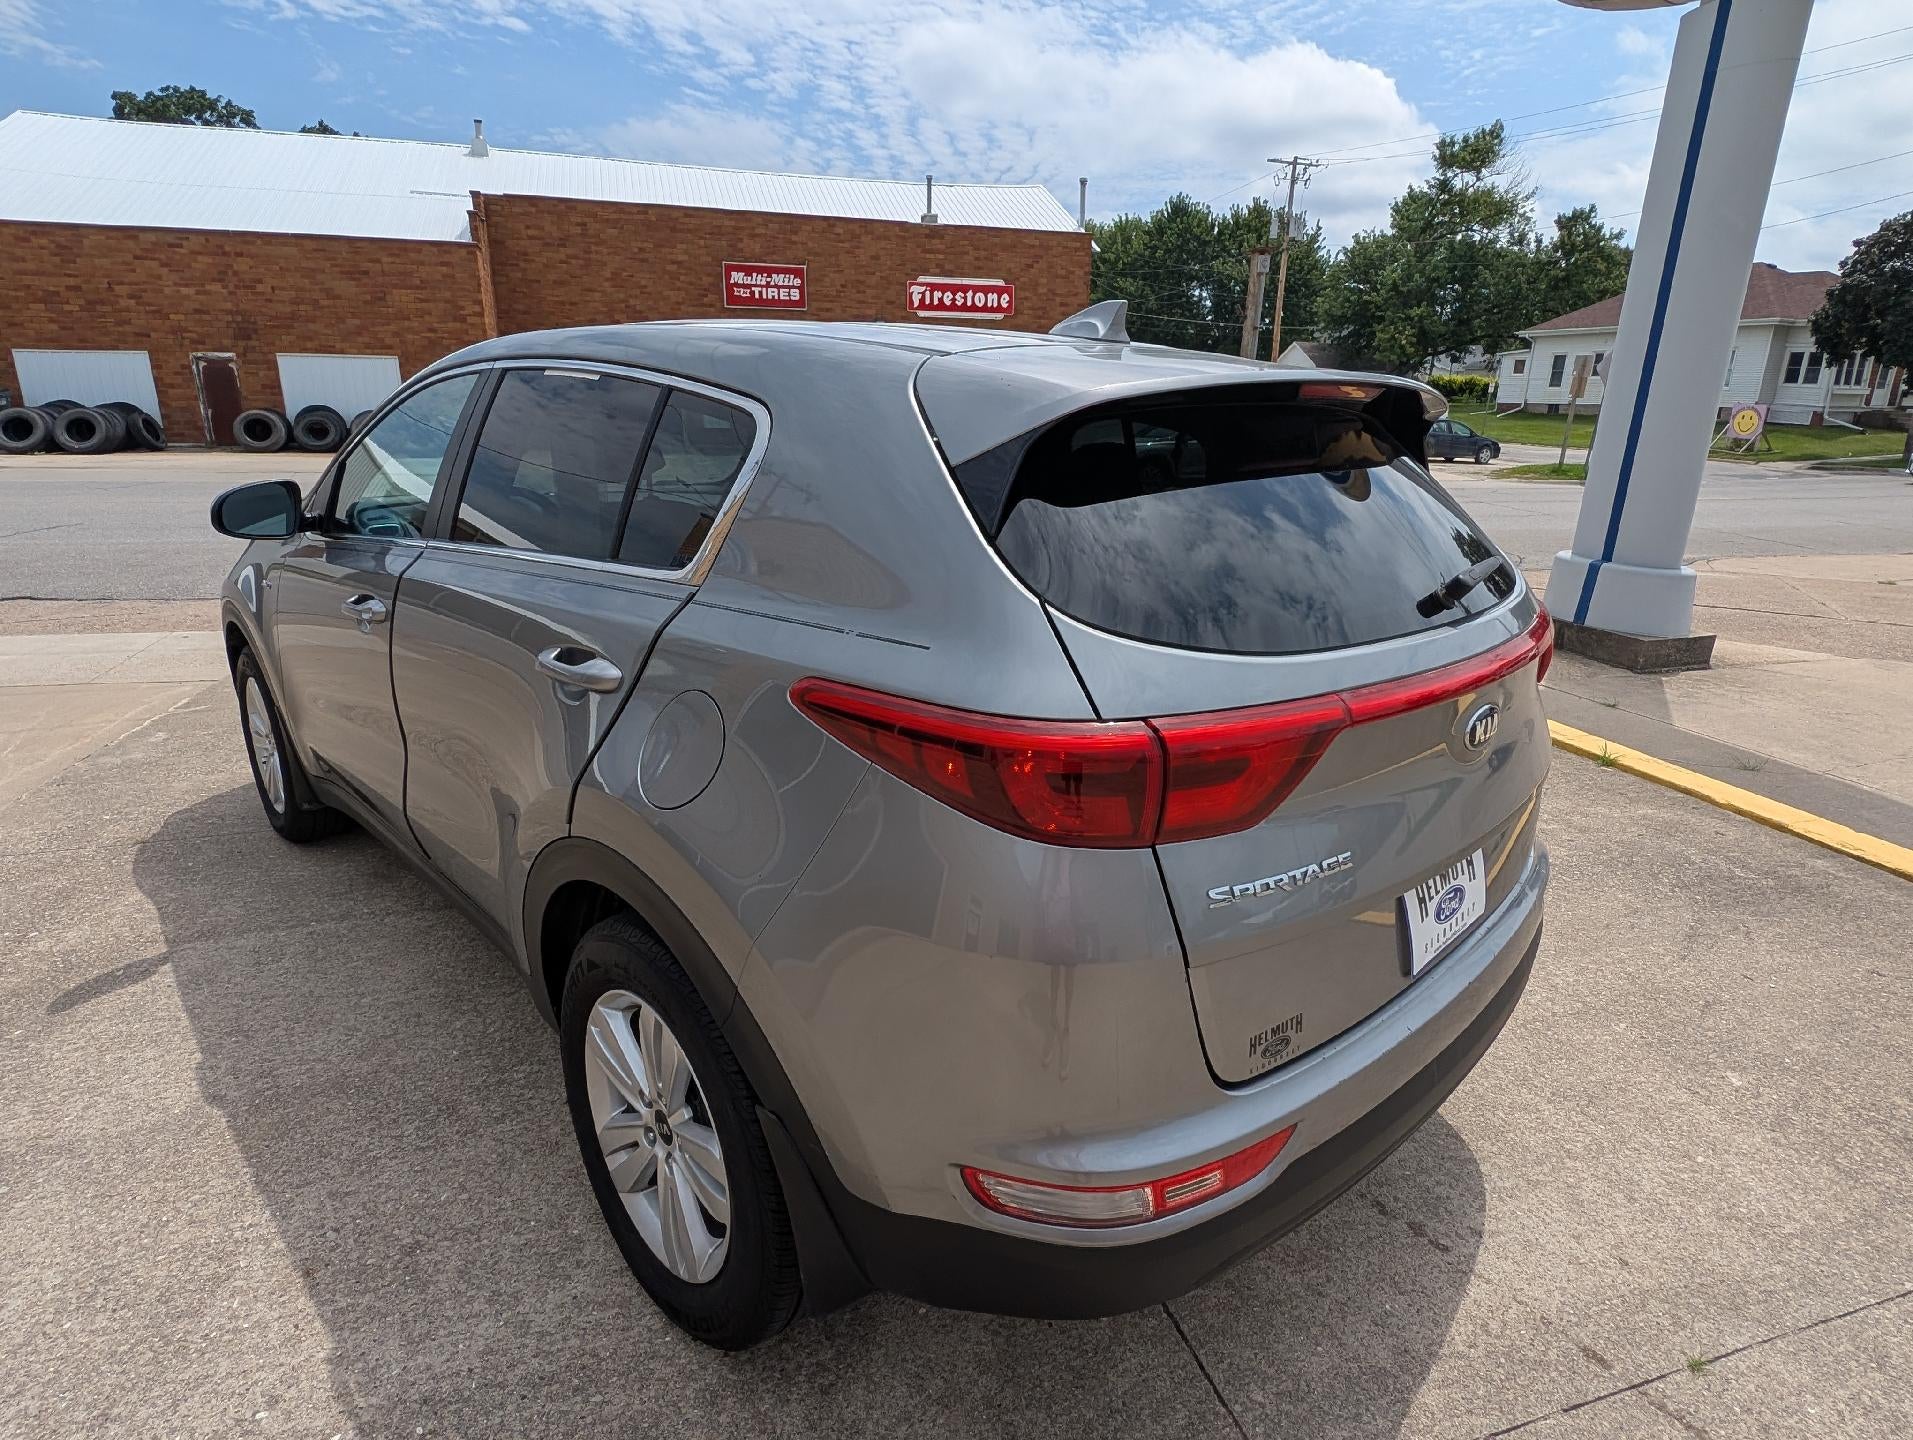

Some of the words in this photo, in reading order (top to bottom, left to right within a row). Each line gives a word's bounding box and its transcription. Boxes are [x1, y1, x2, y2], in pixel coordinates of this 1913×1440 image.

[730, 271, 802, 287] Multi-Mile
[751, 286, 800, 301] TIRES
[909, 284, 1010, 308] Firestone
[1473, 713, 1498, 745] KIA
[1208, 851, 1353, 909] SPORTAGE
[1414, 855, 1477, 924] HELMUTH
[1440, 891, 1461, 921] Ford
[1249, 1012, 1303, 1058] HELMUTH
